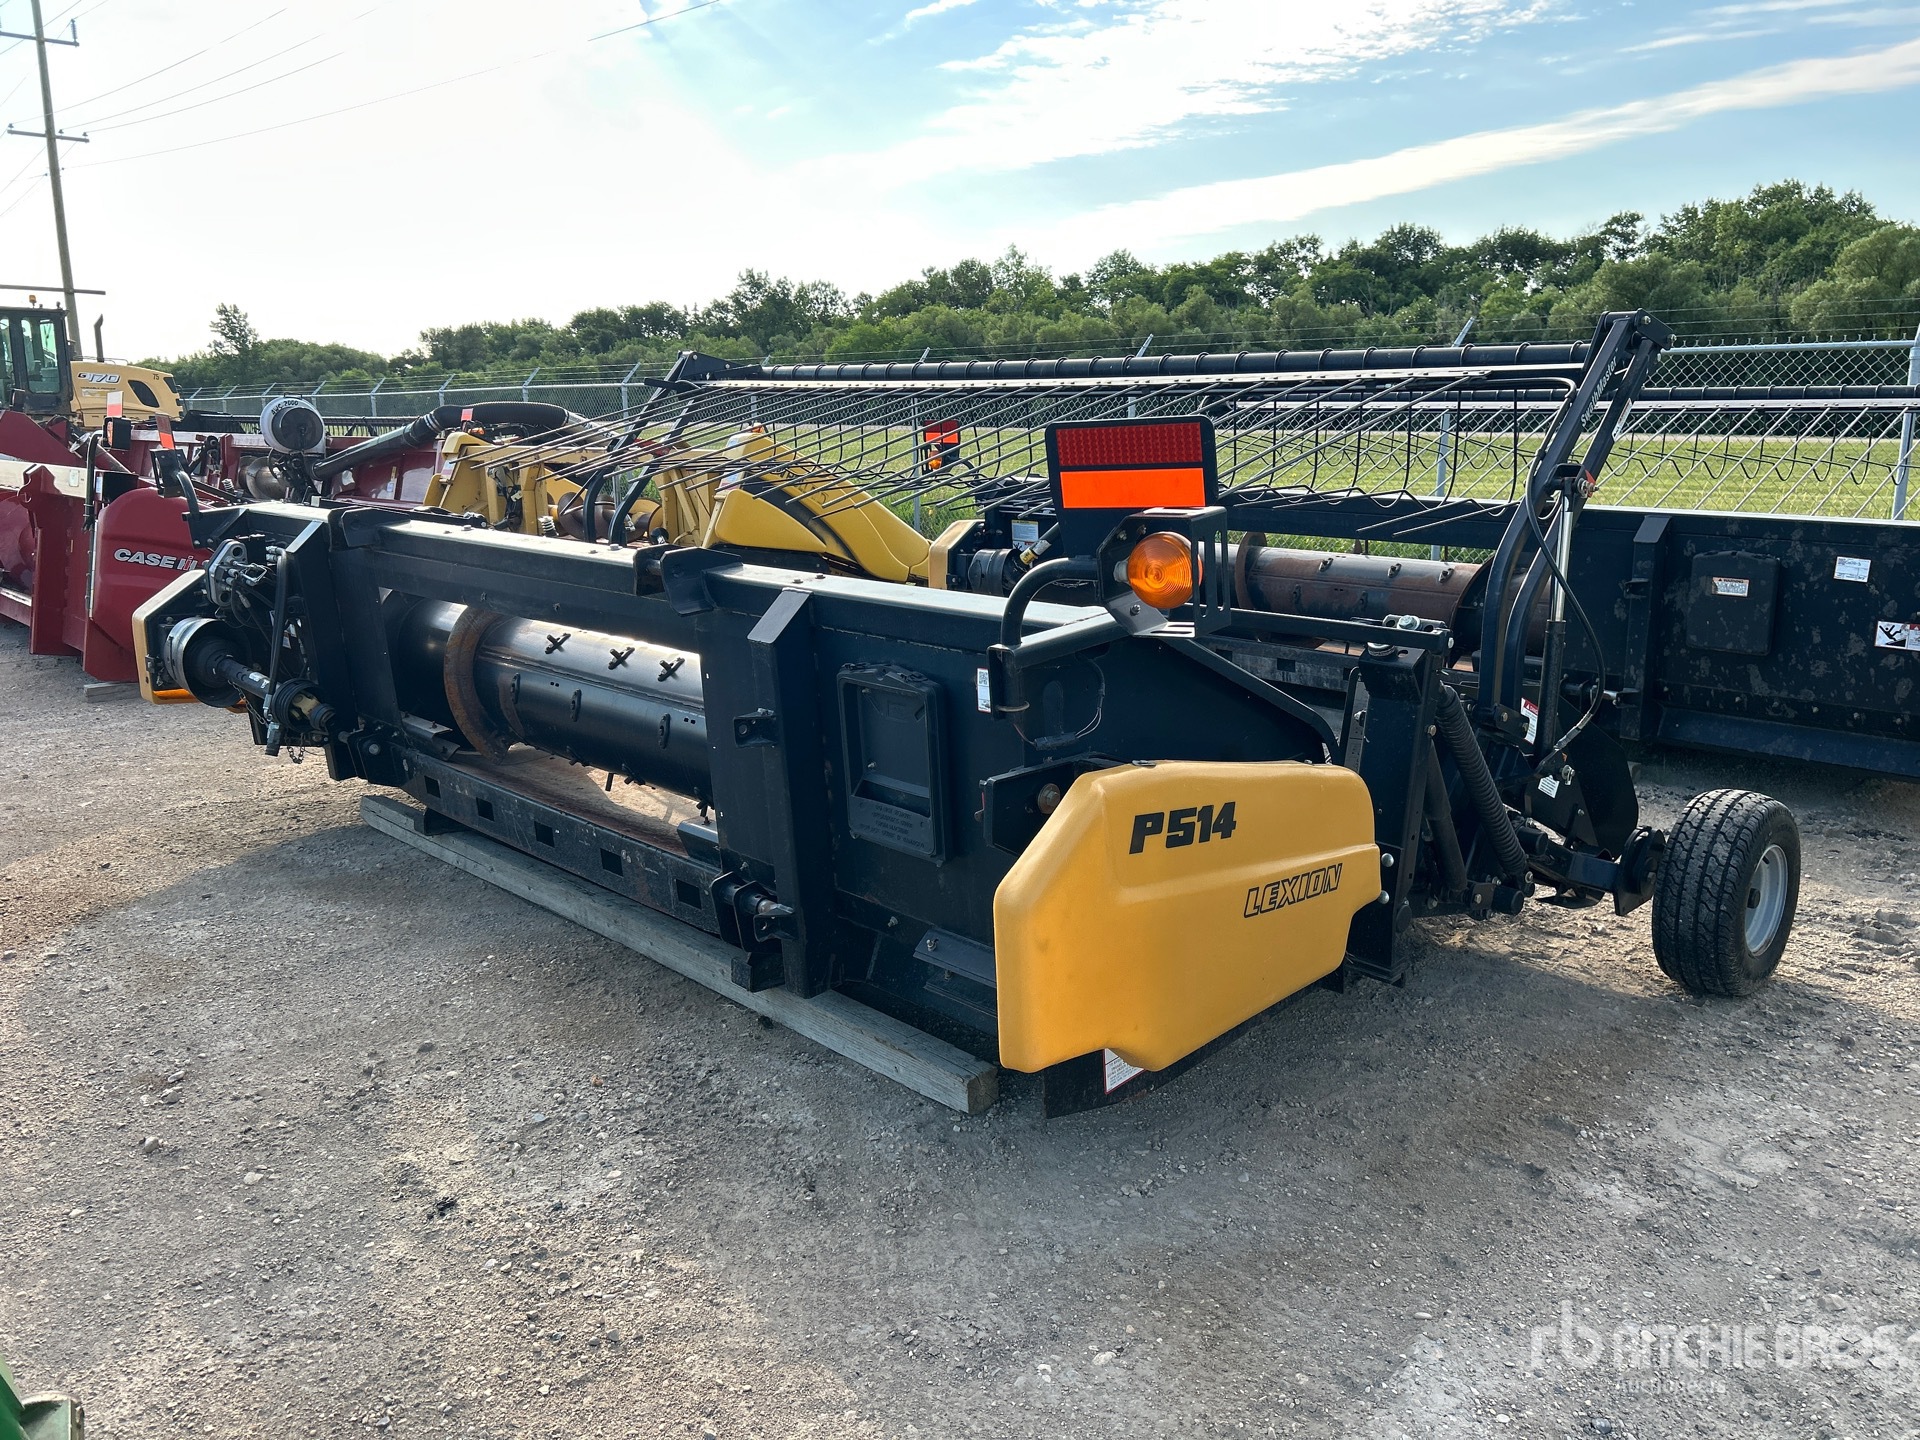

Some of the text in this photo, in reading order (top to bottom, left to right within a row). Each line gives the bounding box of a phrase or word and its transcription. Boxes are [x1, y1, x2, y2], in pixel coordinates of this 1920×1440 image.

[152, 373, 160, 381] 75
[1580, 356, 1618, 428] SwathMaster
[113, 548, 177, 569] CASE
[1128, 801, 1237, 855] P514
[1243, 862, 1343, 919] LEXION
